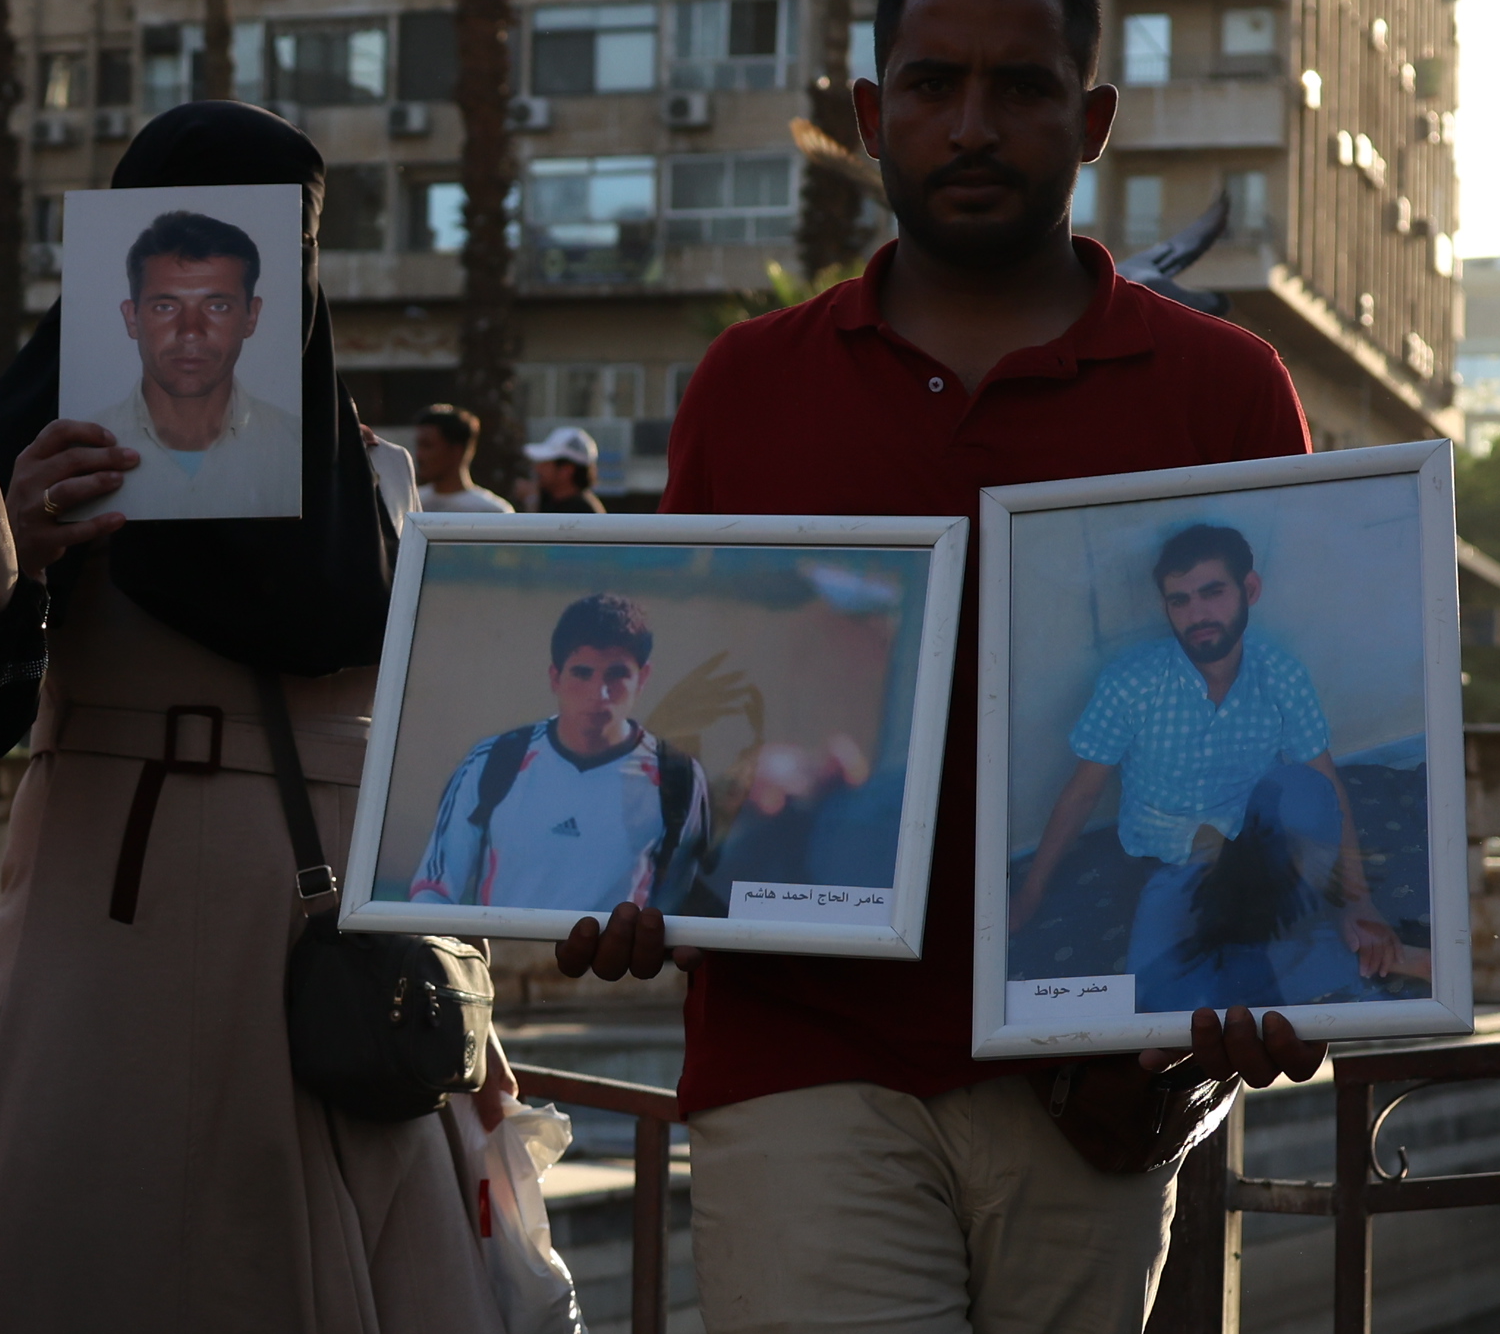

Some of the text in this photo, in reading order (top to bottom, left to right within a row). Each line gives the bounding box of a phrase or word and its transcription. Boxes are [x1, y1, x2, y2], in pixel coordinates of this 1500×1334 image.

[744, 887, 776, 902] هاشم
[817, 891, 849, 906] الحاج
[854, 892, 884, 907] عامر
[1034, 983, 1108, 999] مضر حواط
